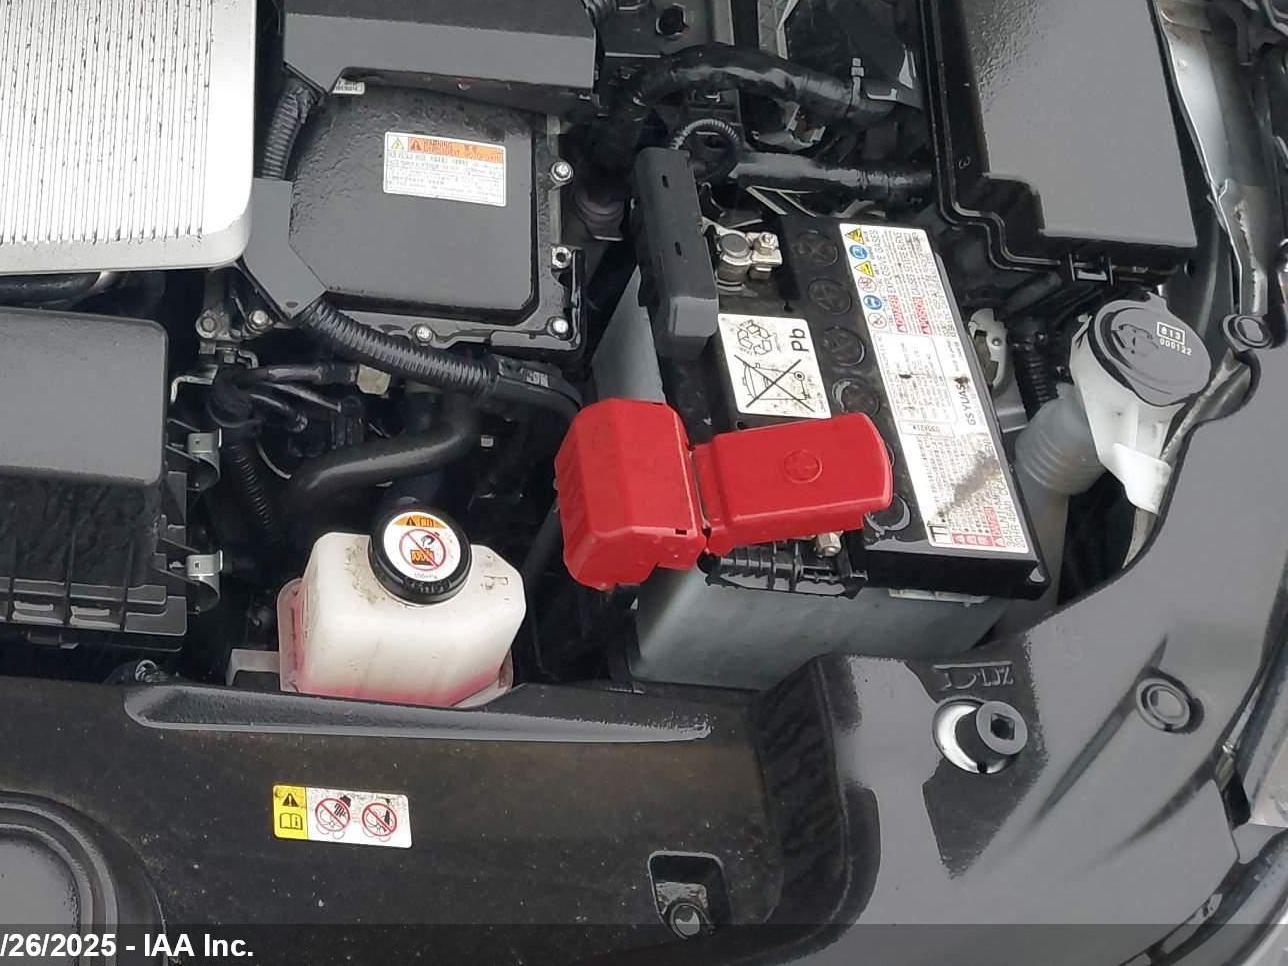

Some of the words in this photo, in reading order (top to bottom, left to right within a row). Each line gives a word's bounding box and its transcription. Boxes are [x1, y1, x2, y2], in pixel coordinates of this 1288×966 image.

[869, 229, 884, 253] GASES
[877, 254, 896, 294] EXPLOSIVE
[907, 273, 921, 296] CAUSES
[789, 328, 809, 352] Pb
[1159, 338, 1192, 356] 000122
